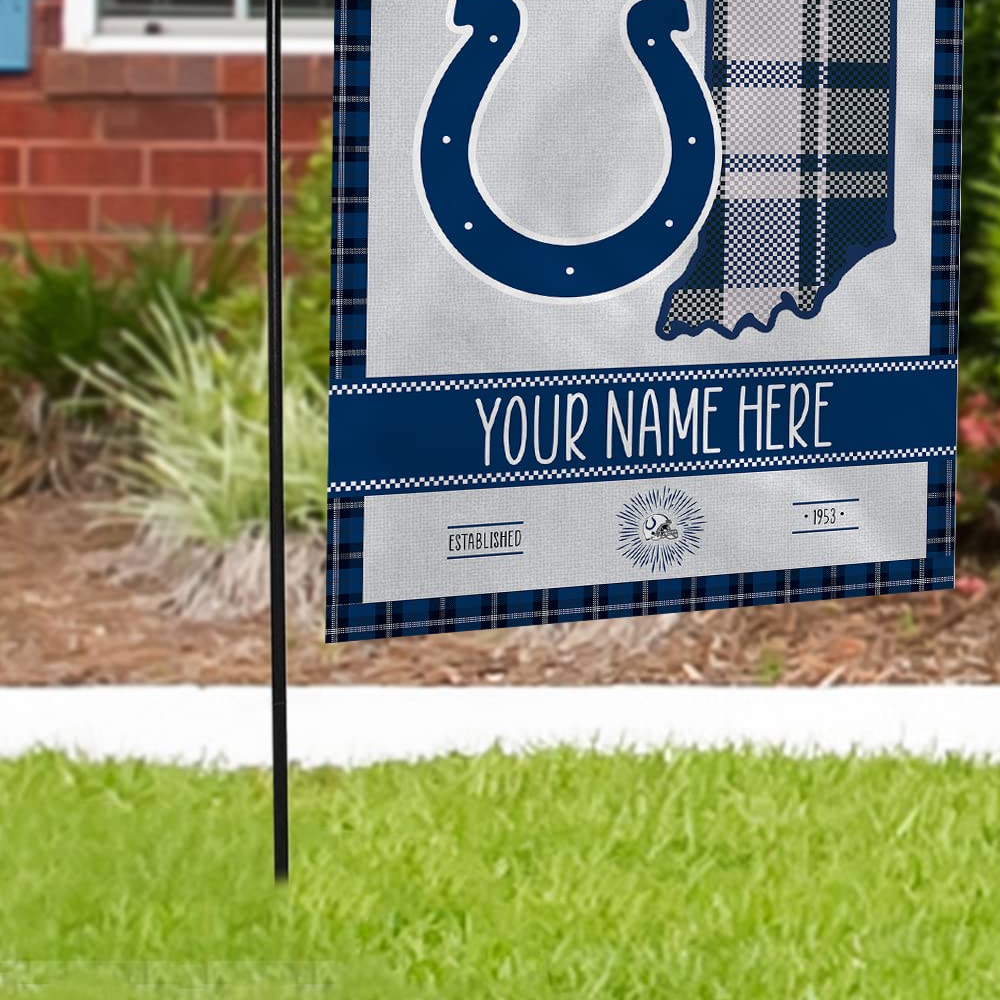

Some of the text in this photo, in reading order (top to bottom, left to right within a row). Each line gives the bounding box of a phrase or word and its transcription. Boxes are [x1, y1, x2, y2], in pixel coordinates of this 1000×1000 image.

[475, 381, 834, 467] YOUR NAME HERE
[813, 507, 837, 526] 1953
[448, 529, 522, 552] ESTABLISHED
